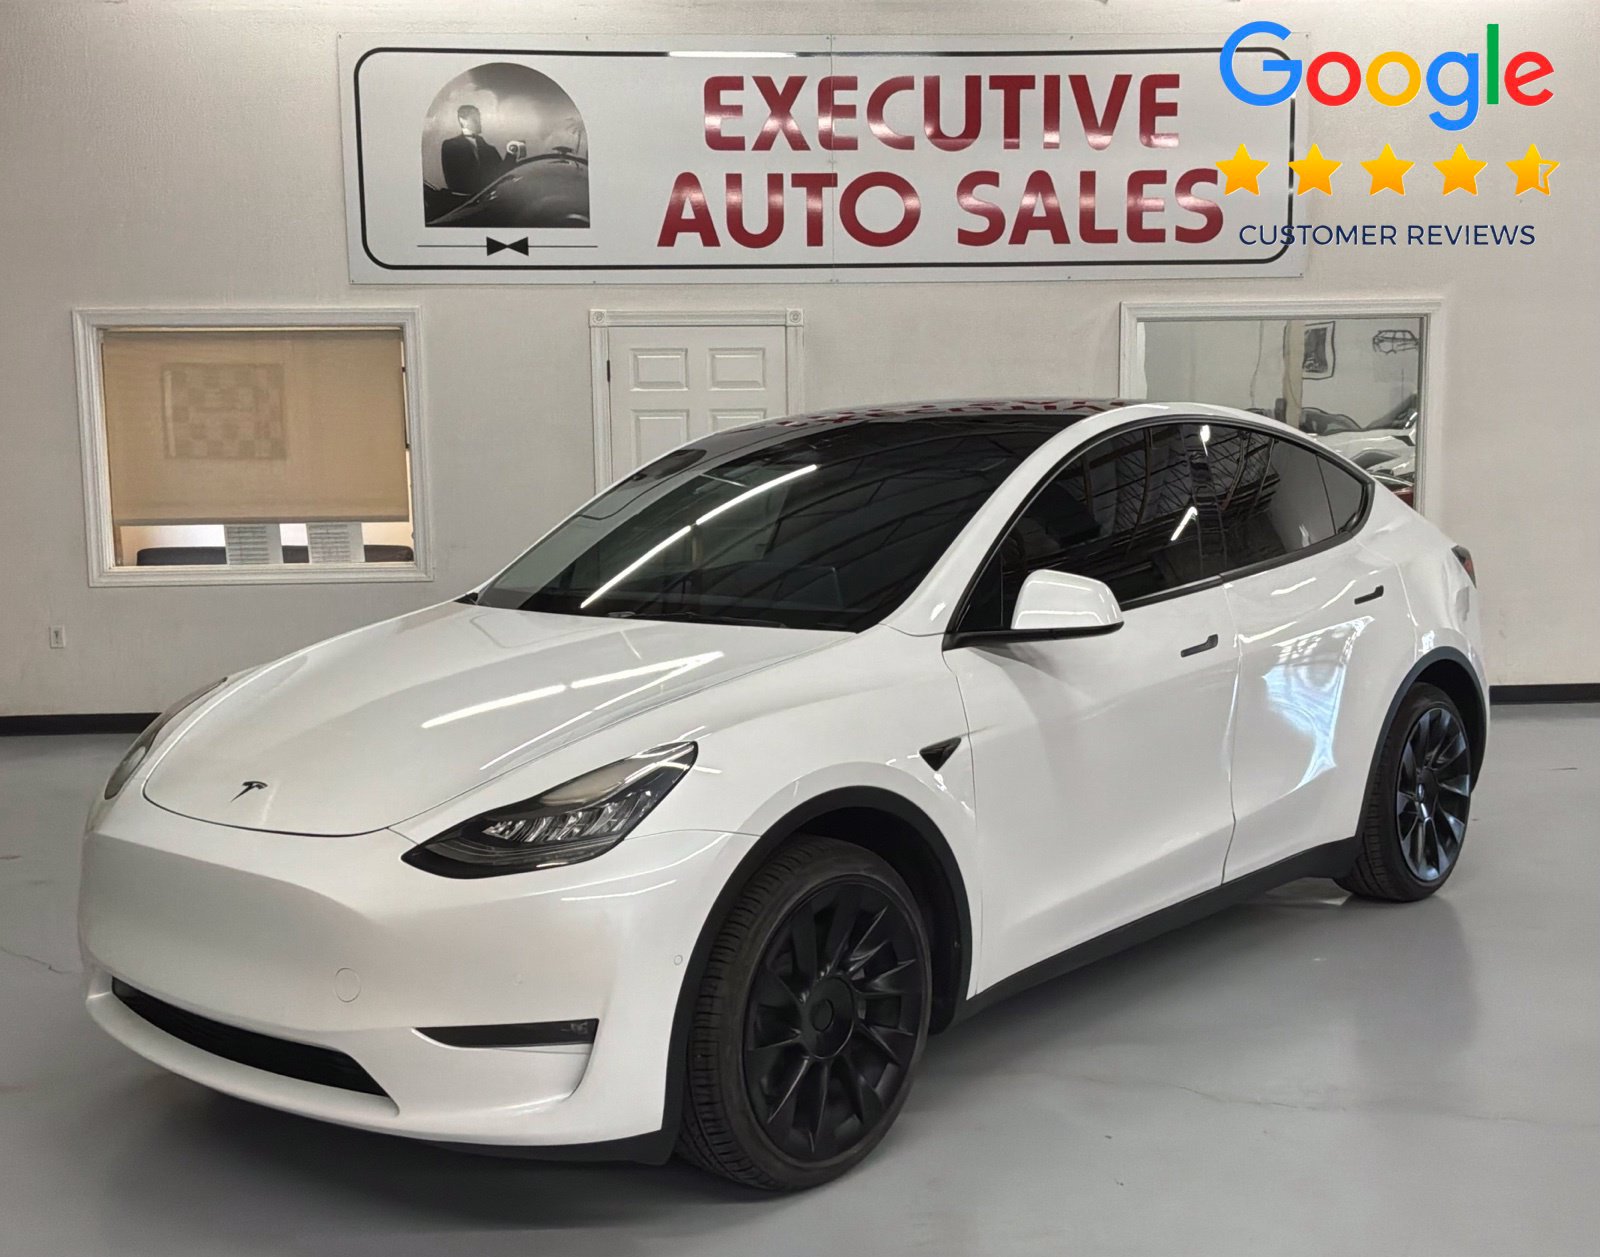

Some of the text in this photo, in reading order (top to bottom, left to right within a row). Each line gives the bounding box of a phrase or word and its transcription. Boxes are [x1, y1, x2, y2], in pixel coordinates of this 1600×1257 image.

[703, 73, 1181, 152] EXECUTIVE
[657, 168, 1224, 249] AUTO SALES
